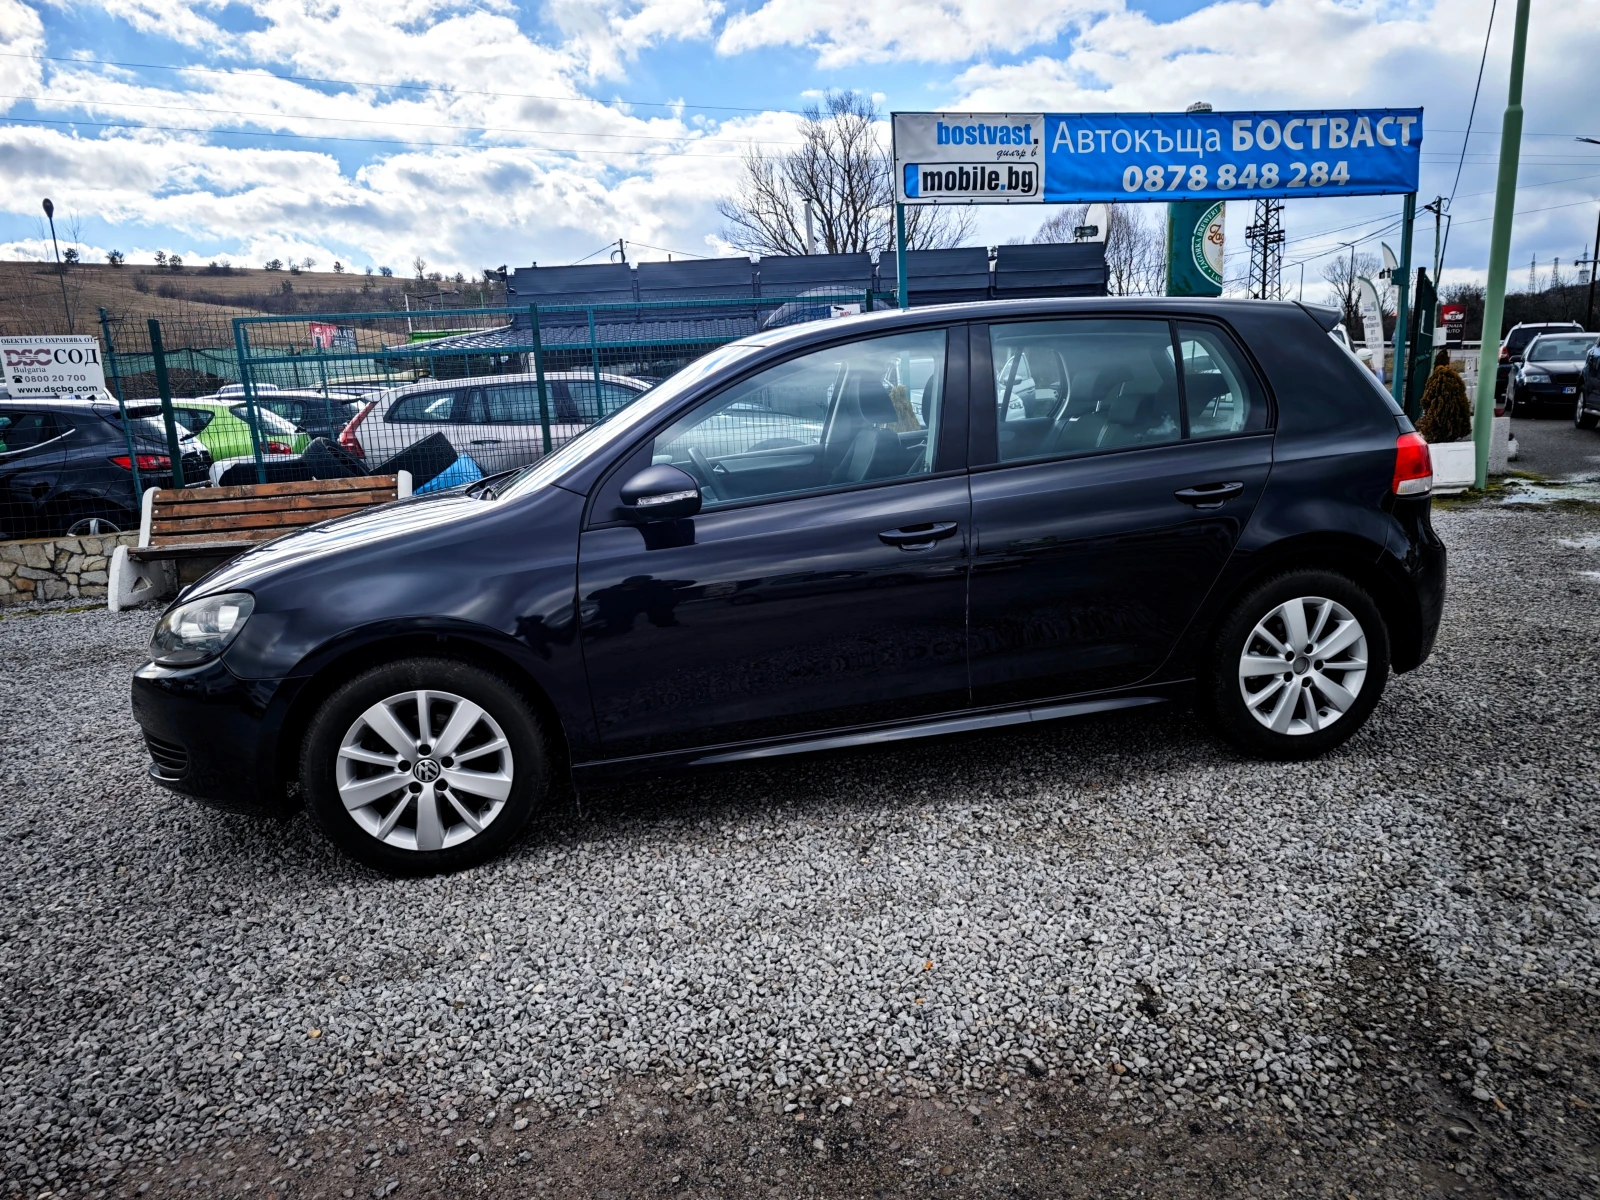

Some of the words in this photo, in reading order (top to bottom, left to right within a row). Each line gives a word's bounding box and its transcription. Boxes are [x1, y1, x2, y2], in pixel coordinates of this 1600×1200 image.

[1232, 115, 1418, 152] БОСТВАСТ
[922, 165, 1034, 194] mobile.bg
[1122, 164, 1208, 193] 0878
[1216, 162, 1280, 191] 848
[1286, 160, 1350, 188] 284
[1197, 208, 1218, 236] BREWERY
[3, 348, 53, 367] DSC
[54, 348, 100, 367] СОД
[13, 366, 47, 375] Bulgaria
[24, 375, 50, 383] 0800
[67, 374, 86, 382] 700
[17, 385, 98, 394] www.dscbg.com
